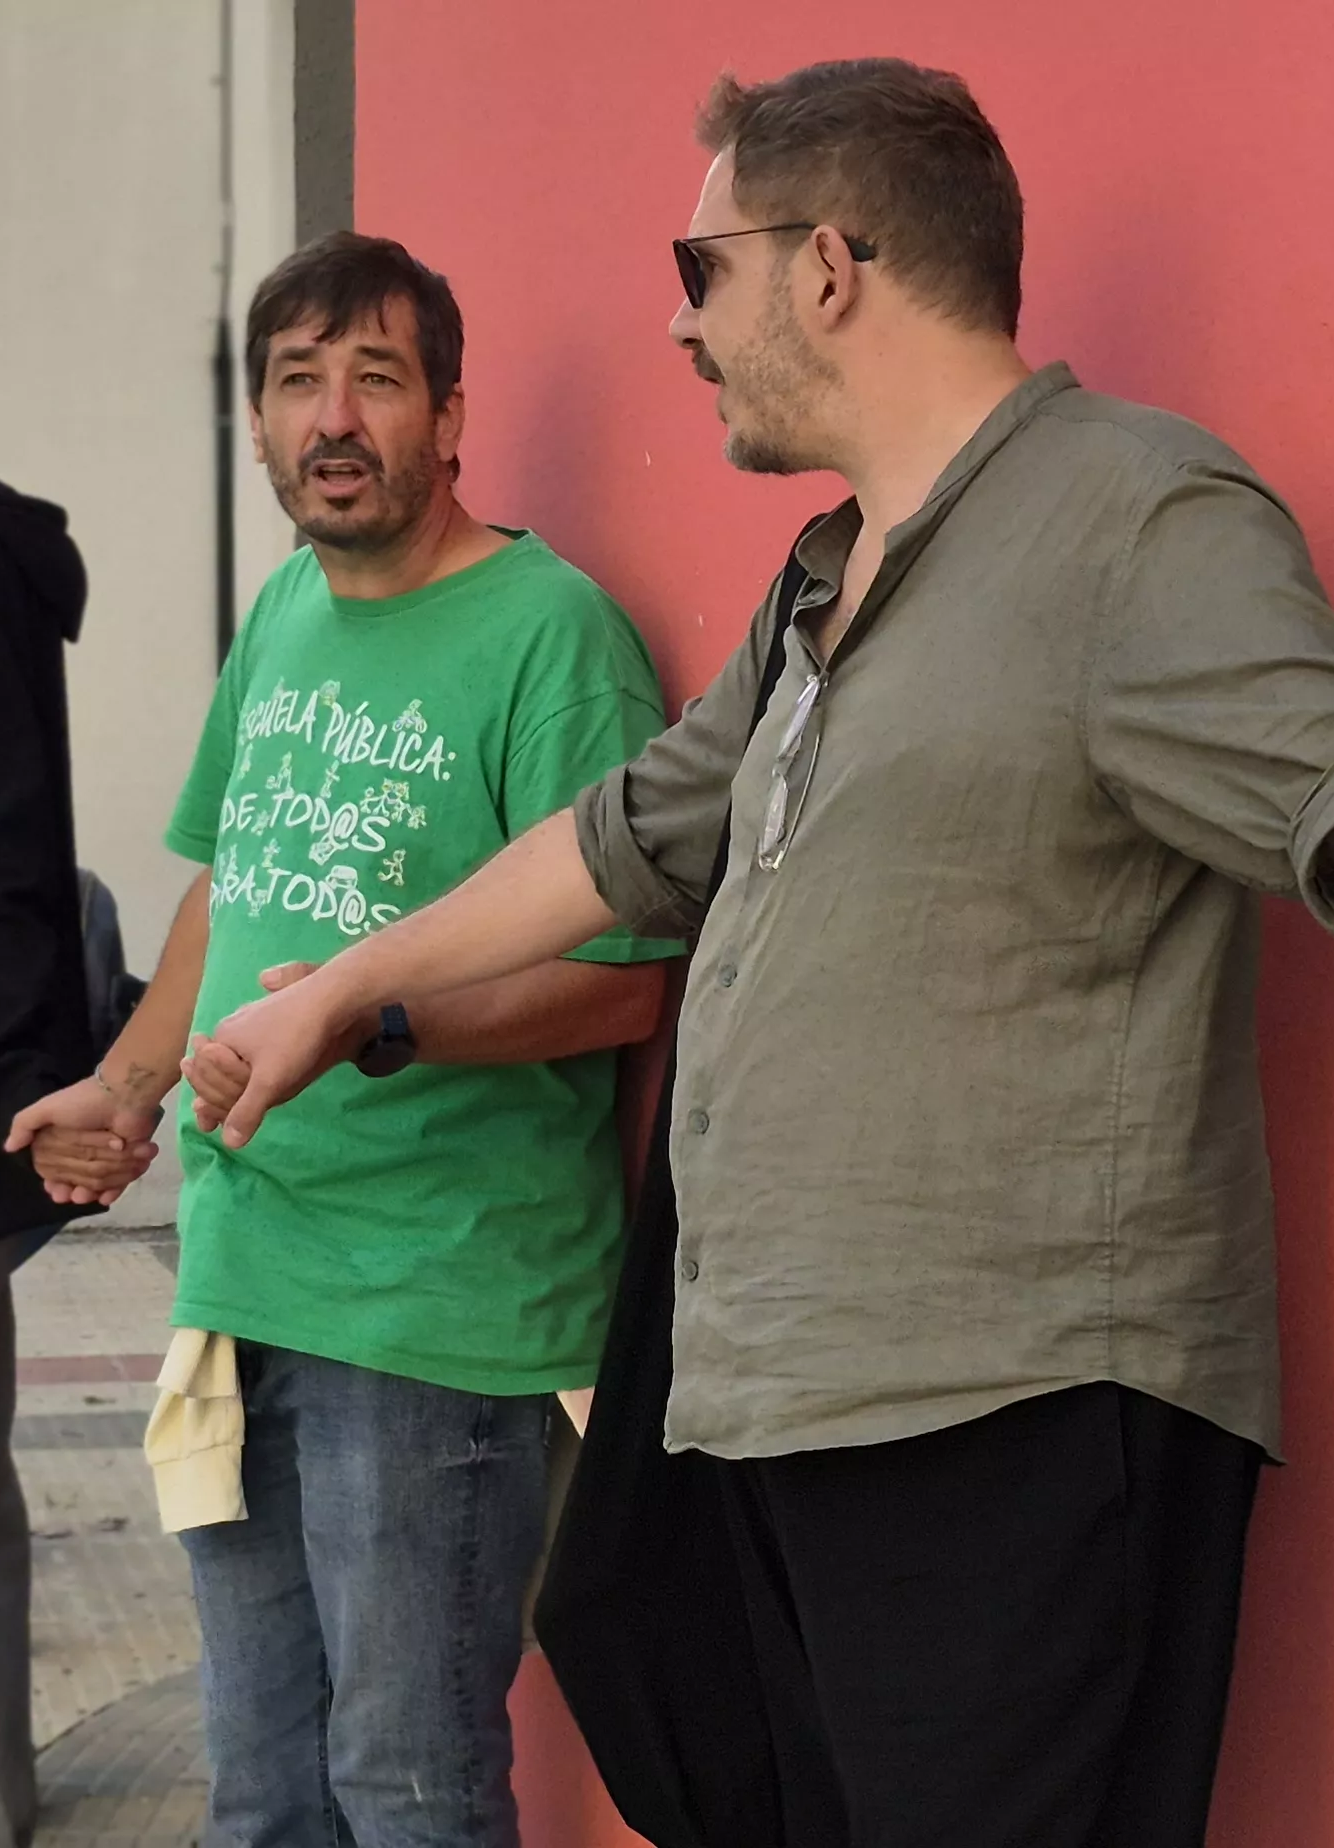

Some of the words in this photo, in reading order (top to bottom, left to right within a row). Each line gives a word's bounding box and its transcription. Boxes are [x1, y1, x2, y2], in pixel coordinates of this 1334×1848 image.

[238, 690, 317, 743] SCUELA
[322, 701, 456, 781] PÚBLICA:
[220, 793, 258, 832] DE
